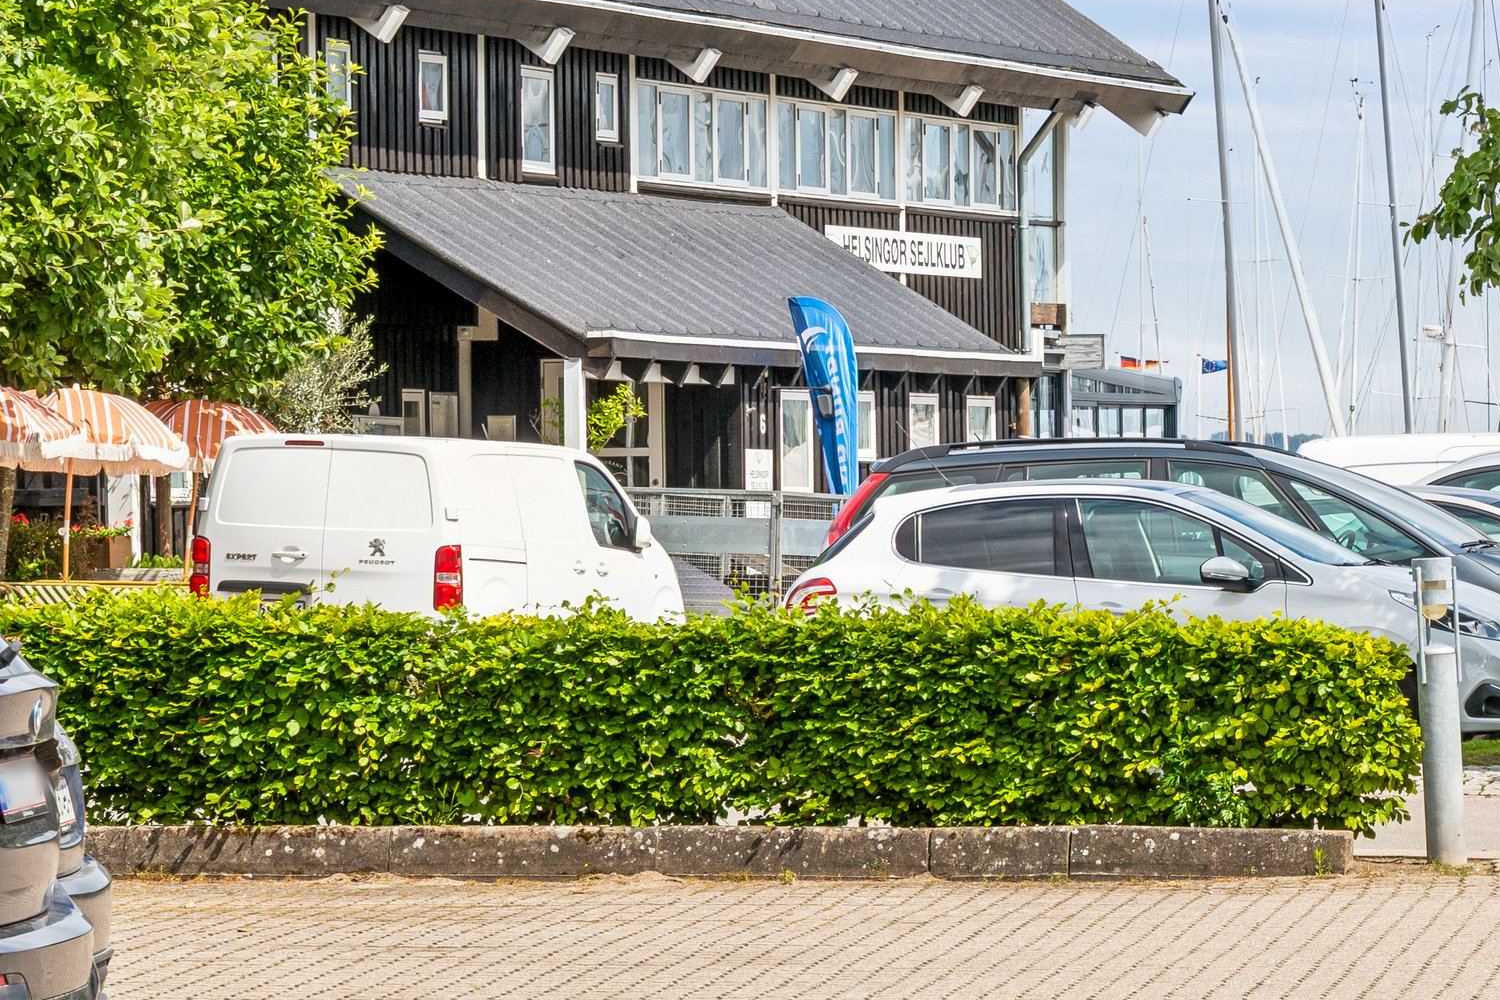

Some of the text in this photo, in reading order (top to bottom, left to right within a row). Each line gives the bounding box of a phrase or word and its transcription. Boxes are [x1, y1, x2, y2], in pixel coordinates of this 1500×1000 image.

[843, 234, 966, 270] HELSINGØR SEJLKLUB
[760, 413, 766, 435] 6
[225, 552, 258, 561] EXPERT
